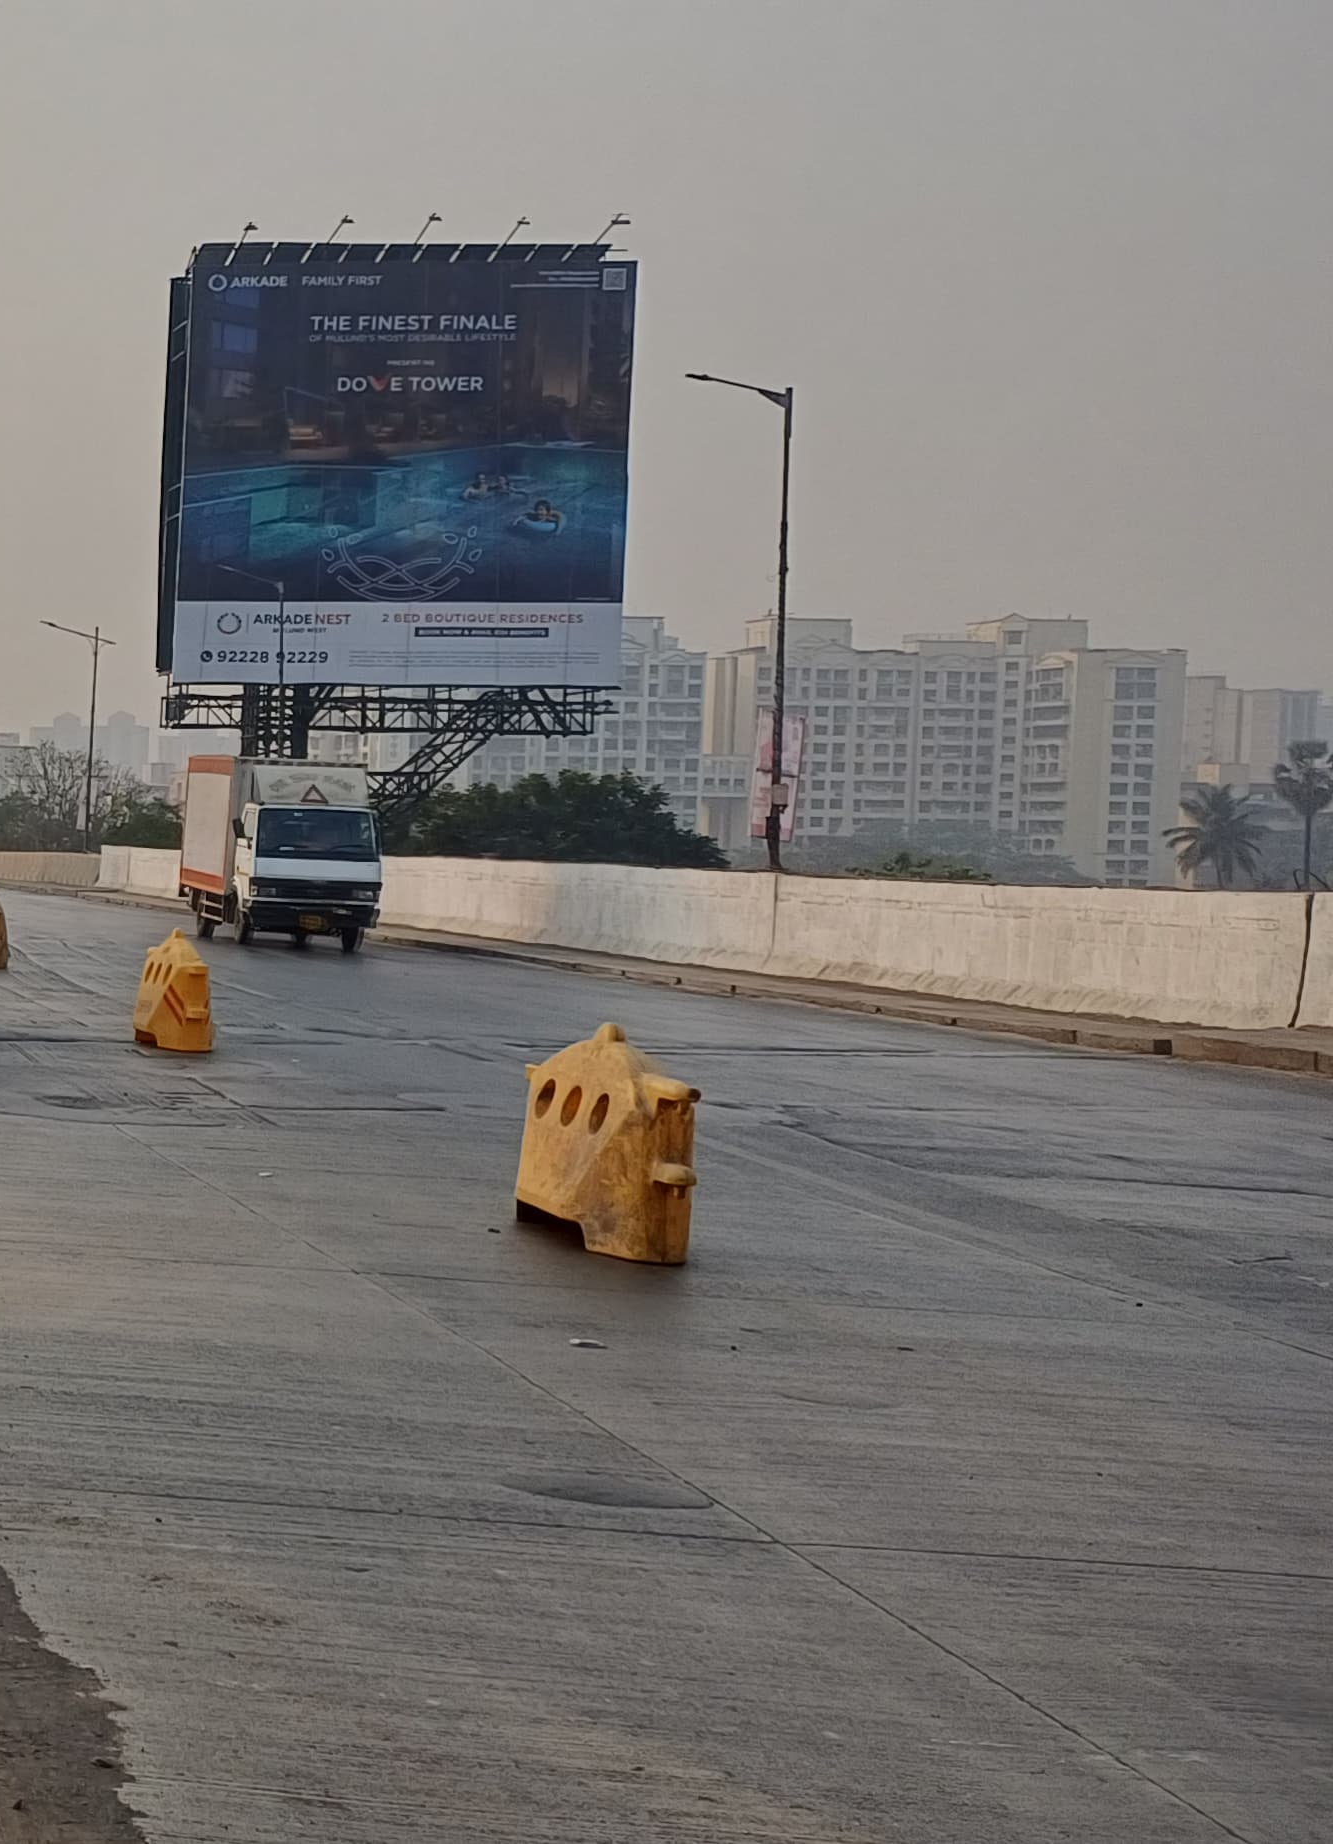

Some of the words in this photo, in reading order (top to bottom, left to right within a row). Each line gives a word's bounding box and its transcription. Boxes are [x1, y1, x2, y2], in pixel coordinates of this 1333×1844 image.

[230, 276, 289, 288] ARKADE
[301, 275, 345, 286] FAMILY
[347, 275, 382, 286] FIRST
[310, 315, 352, 331] THE
[358, 314, 433, 331] FINEST
[439, 314, 518, 330] FINALE
[378, 334, 406, 342] MOST
[336, 374, 403, 392] DOVE
[408, 376, 484, 392] TOWER
[381, 614, 389, 623] 2
[393, 614, 420, 623] BED
[425, 614, 495, 624] BOUTIQUE
[500, 614, 584, 624] RESIDENCES
[217, 650, 270, 664] 92228
[275, 650, 329, 664] 92229
